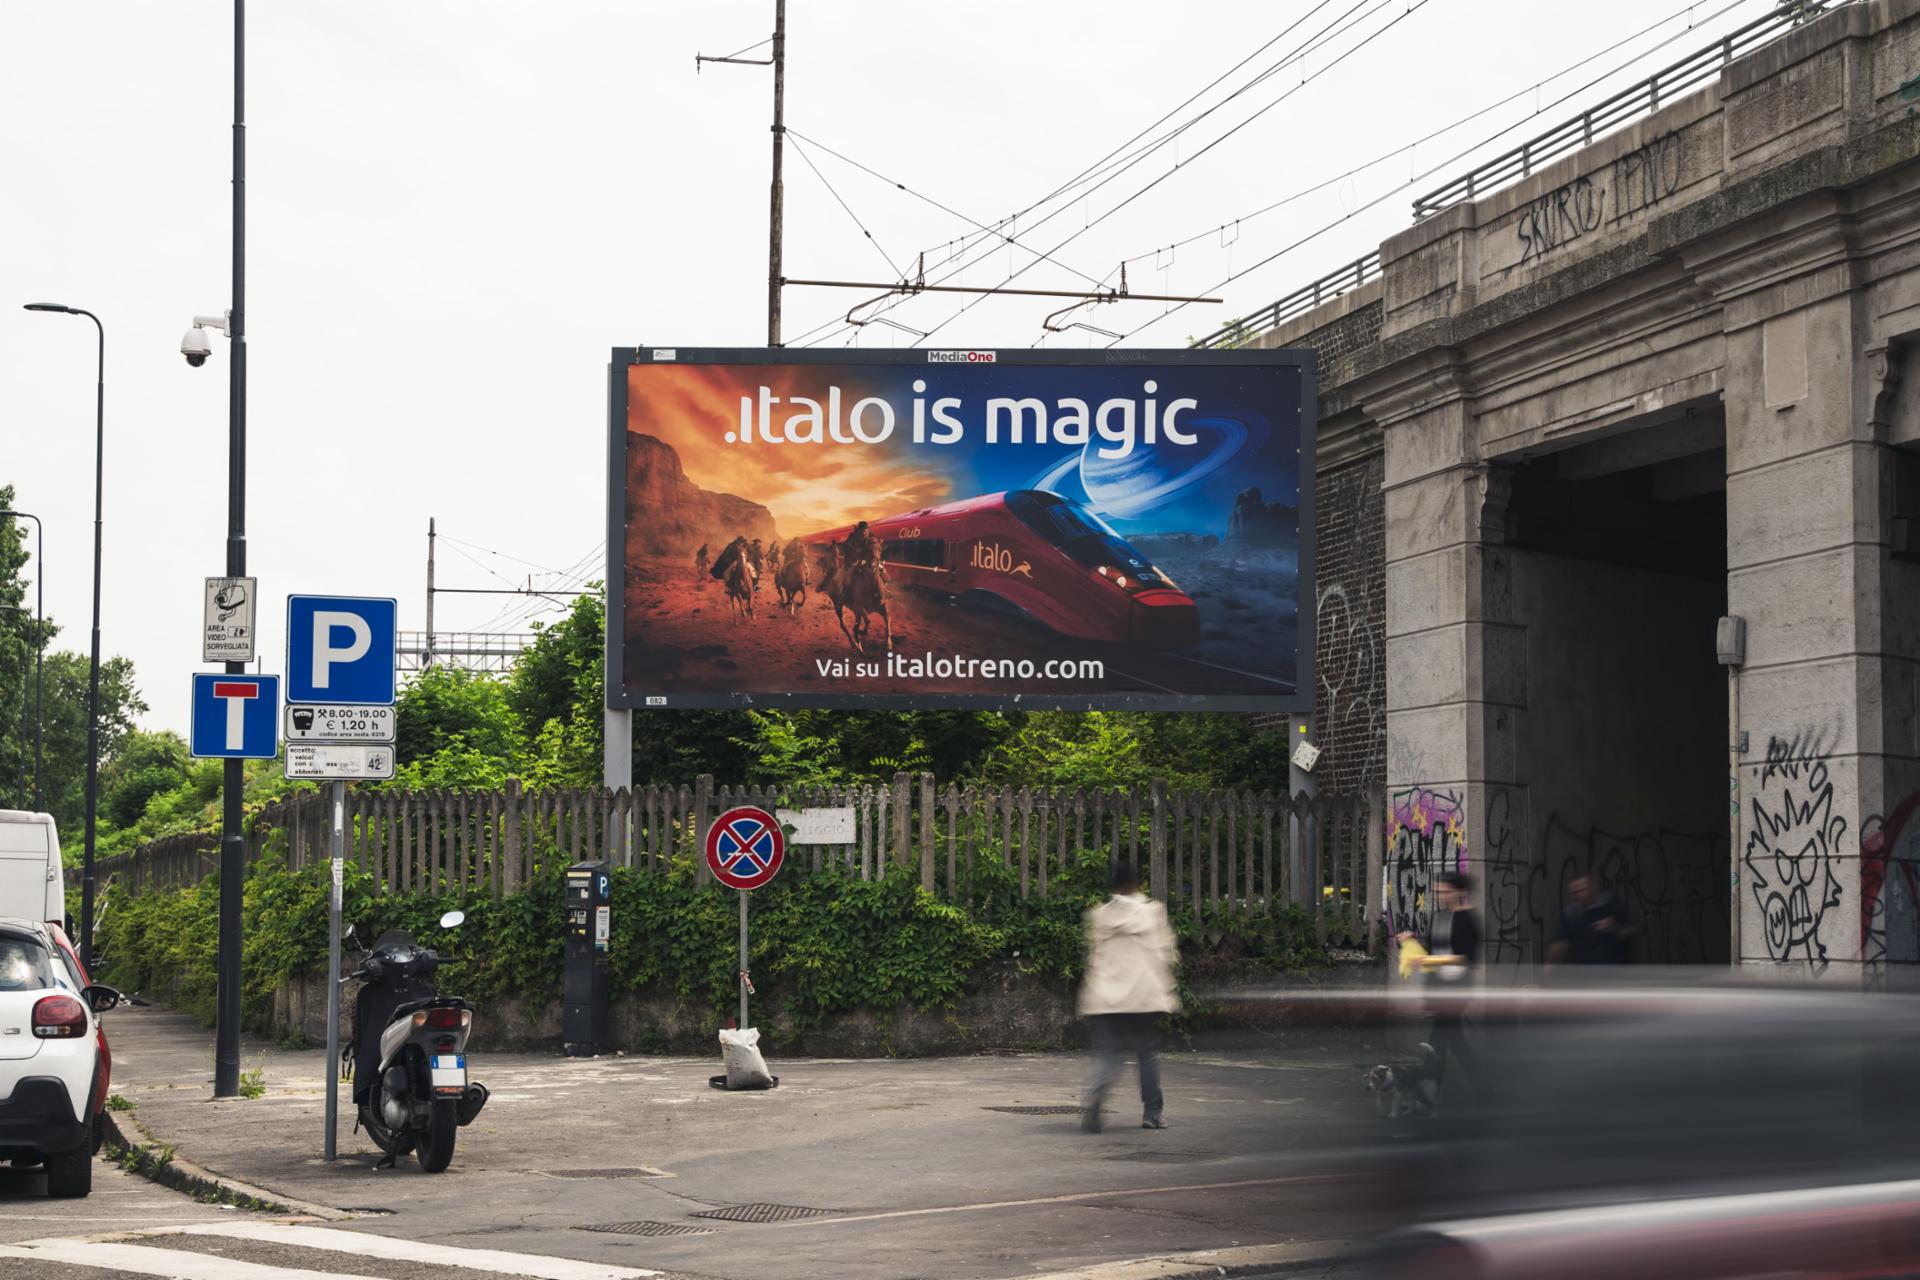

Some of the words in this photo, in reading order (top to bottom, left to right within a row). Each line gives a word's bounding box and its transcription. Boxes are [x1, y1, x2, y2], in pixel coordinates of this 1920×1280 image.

[929, 352, 994, 362] MediaOne
[912, 379, 964, 443] is
[985, 379, 1199, 459] magic
[898, 526, 921, 539] Club
[207, 633, 226, 641] VIDEO
[312, 610, 372, 689] P
[816, 658, 850, 677] Vai
[856, 661, 879, 677] su
[887, 652, 1104, 679] italotreno.com
[341, 720, 366, 730] 1.20
[371, 721, 379, 730] h
[599, 876, 608, 894] P
